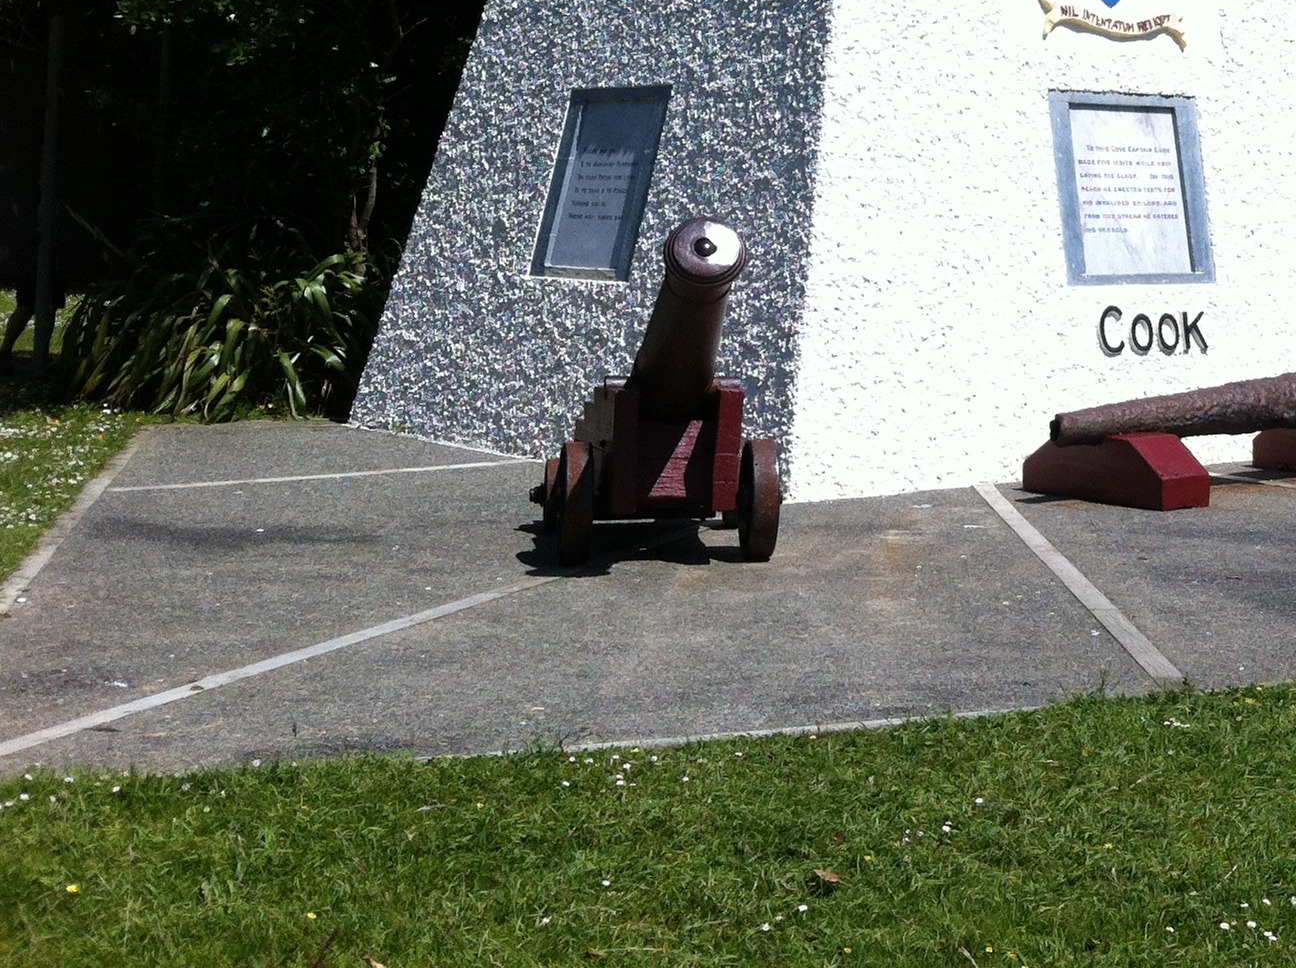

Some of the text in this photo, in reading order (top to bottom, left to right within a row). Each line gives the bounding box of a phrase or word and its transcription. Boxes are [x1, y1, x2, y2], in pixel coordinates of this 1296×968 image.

[1060, 5, 1079, 17] NIL
[1083, 8, 1134, 32] INTENTATUM
[1097, 305, 1208, 357] COOK
